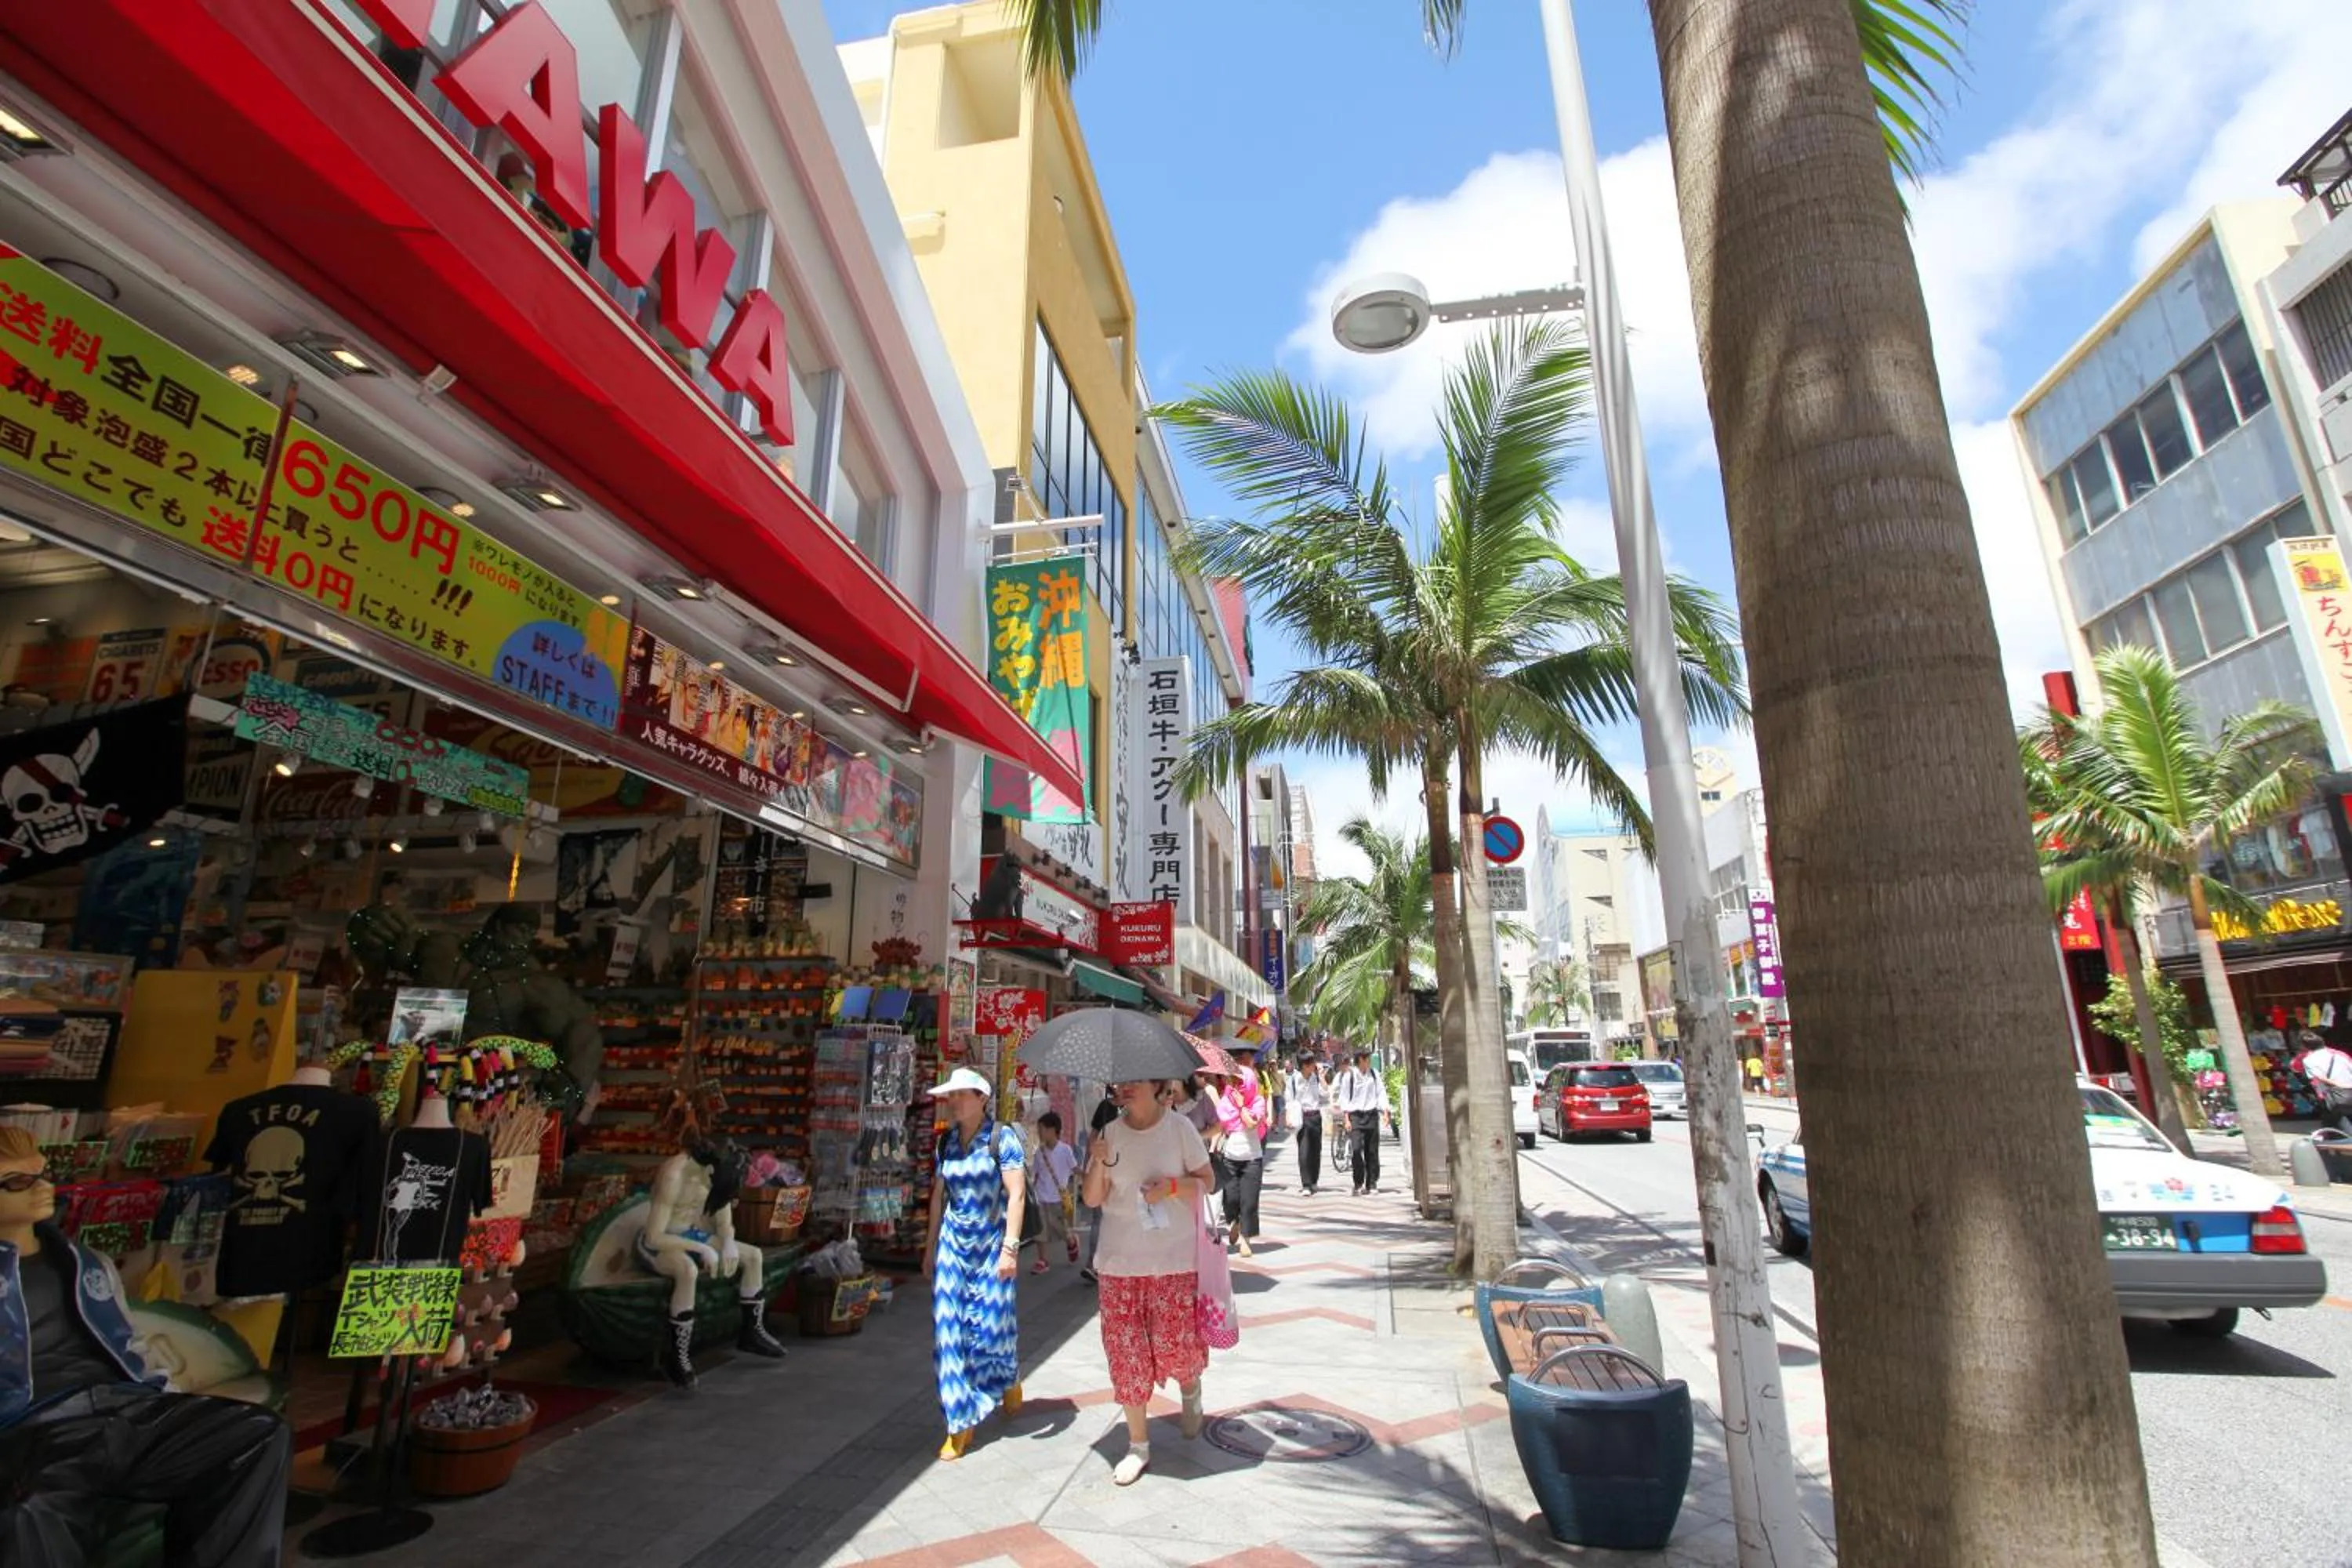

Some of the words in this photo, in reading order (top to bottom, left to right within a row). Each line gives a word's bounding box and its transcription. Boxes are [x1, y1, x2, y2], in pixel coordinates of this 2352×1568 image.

[354, 0, 793, 445] AWA
[91, 661, 146, 703] 65
[1037, 568, 1087, 690] 沖縄
